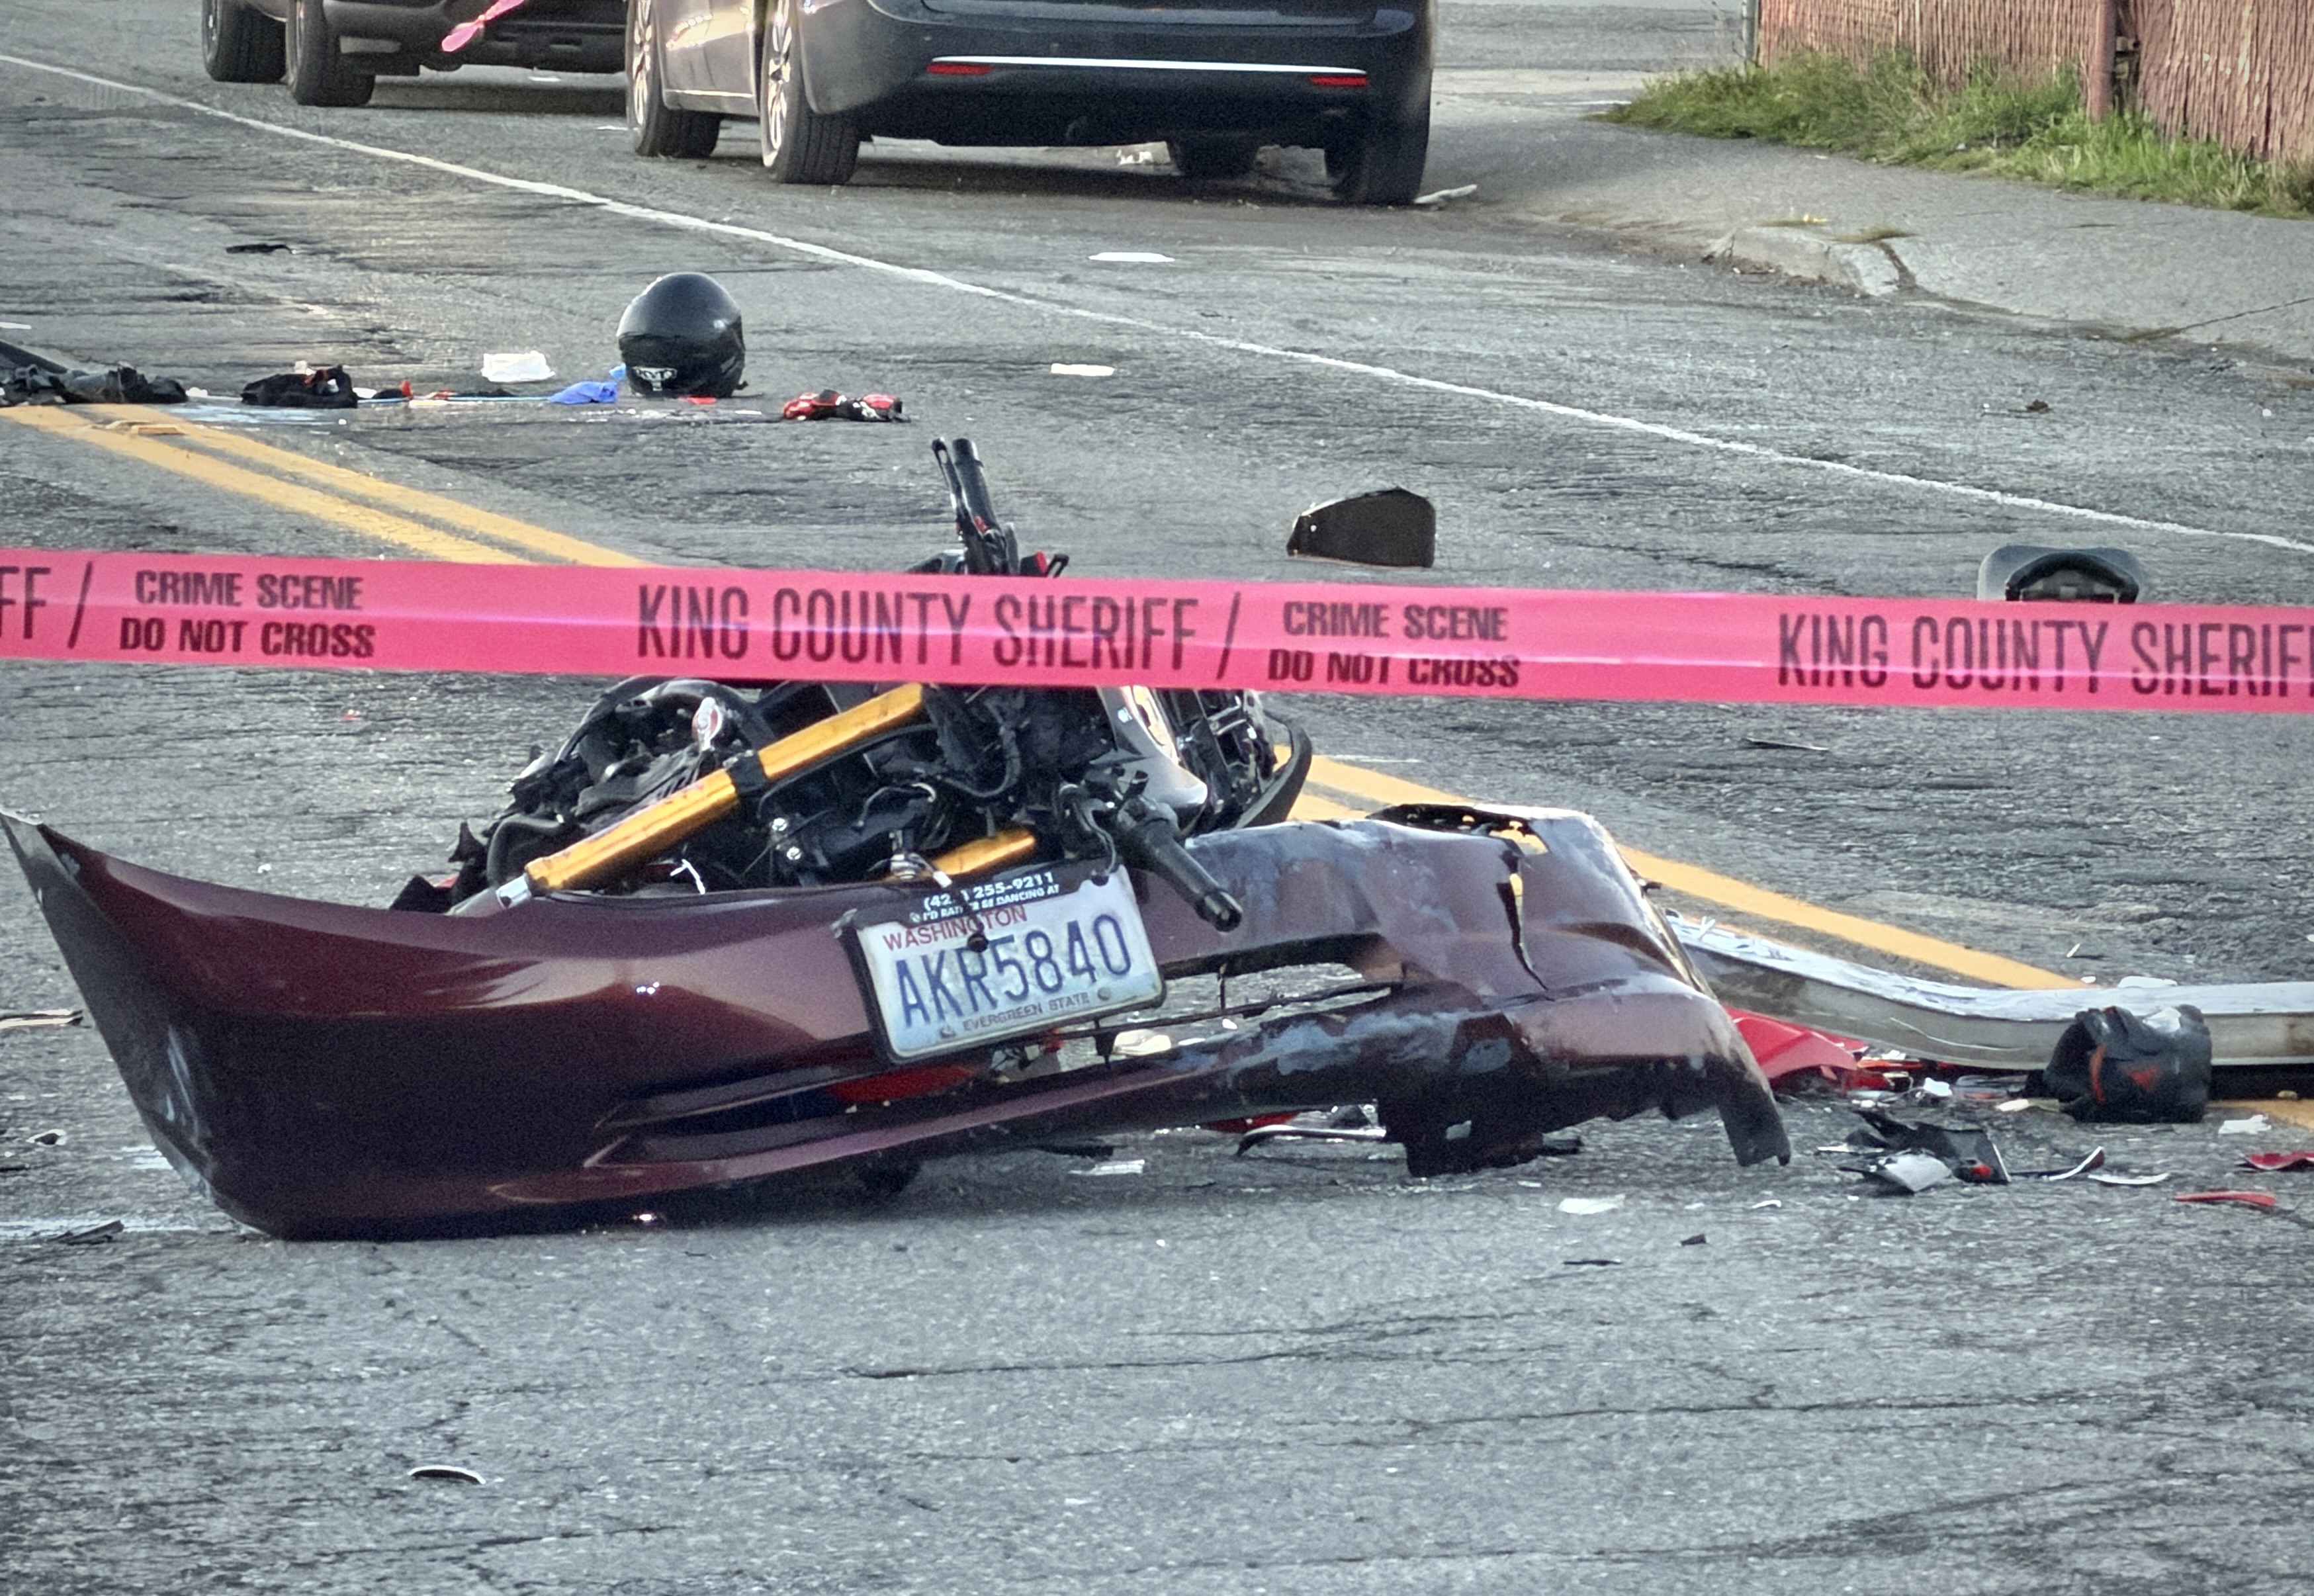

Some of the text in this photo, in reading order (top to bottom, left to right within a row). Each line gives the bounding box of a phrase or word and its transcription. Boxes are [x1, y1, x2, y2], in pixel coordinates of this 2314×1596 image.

[136, 570, 363, 610] CRIME SCENE
[120, 617, 376, 658] DO NOT CROSS
[637, 585, 749, 658] KING
[772, 587, 971, 666] COUNTY
[993, 593, 1199, 671] SHERIFF
[1283, 601, 1508, 641] CRIME SCENE
[1268, 648, 1521, 688] DO NOT CROSS
[1777, 613, 2314, 697] KING COUNTY SHERIF
[923, 871, 1053, 912] (42) 255-9211
[996, 887, 1046, 906] DANCING
[1047, 884, 1059, 895] AT
[895, 914, 1132, 1028] AKR5840
[962, 992, 1090, 1032] EVERGREEN STATE
